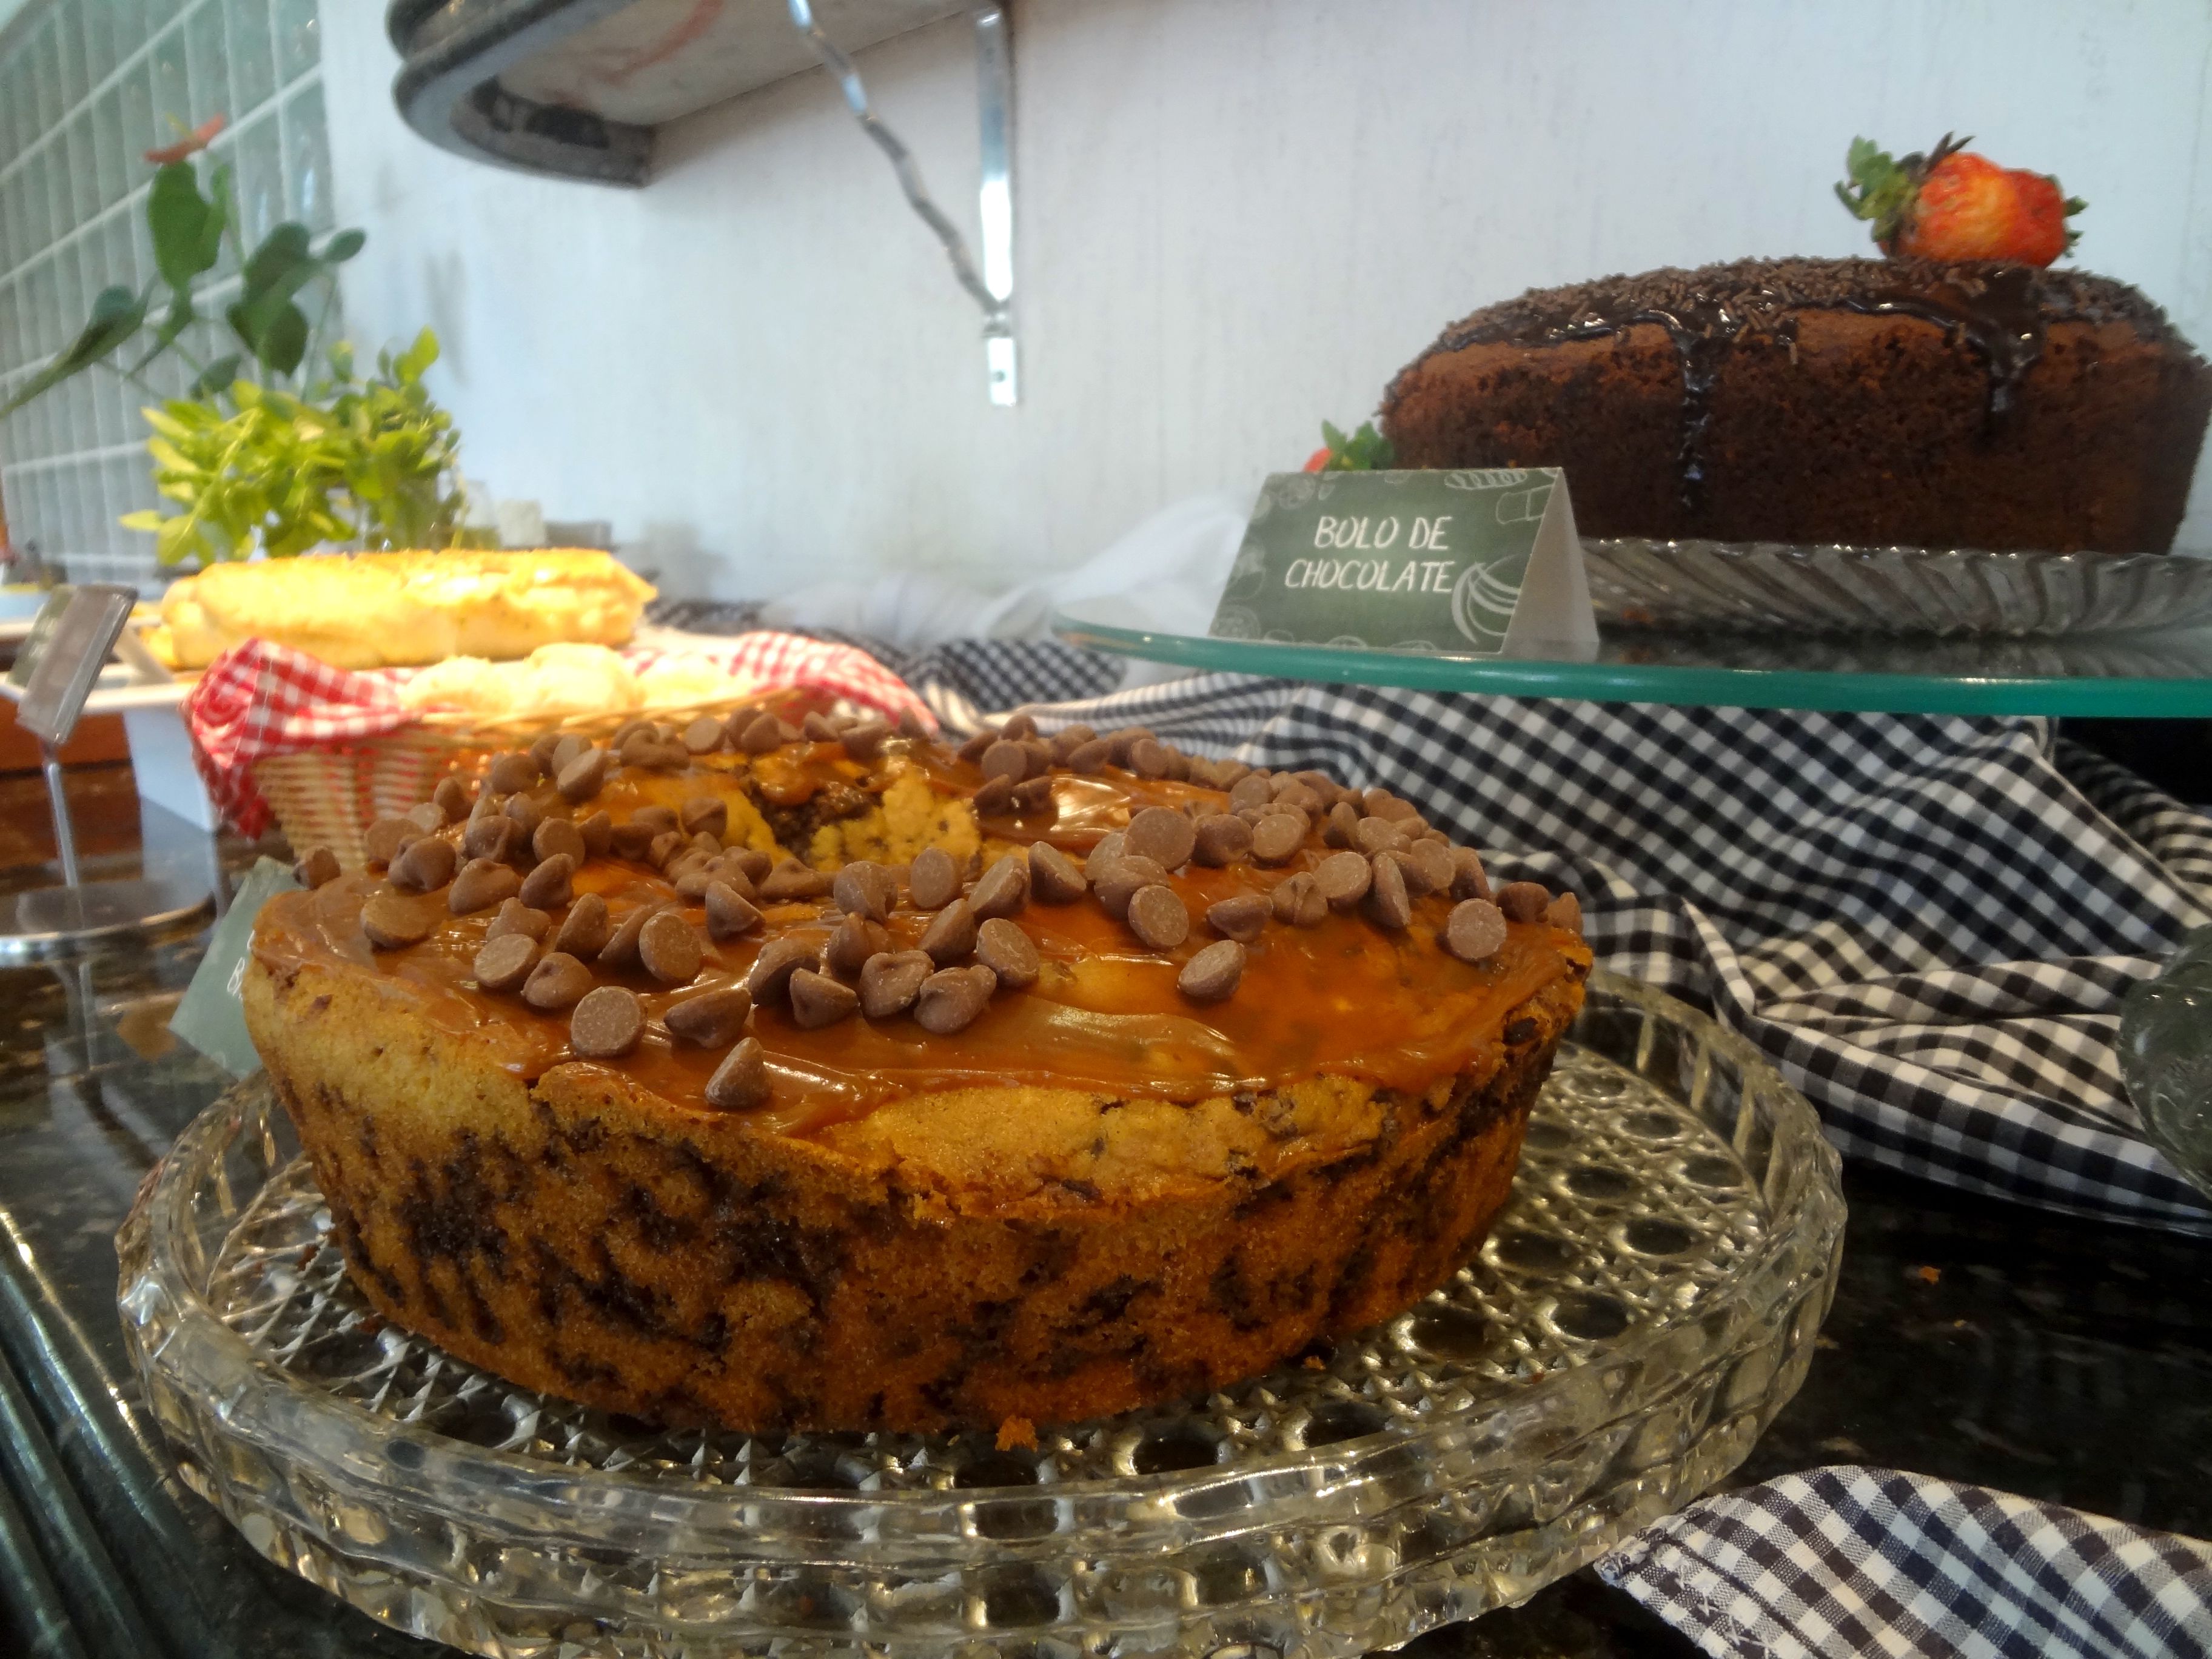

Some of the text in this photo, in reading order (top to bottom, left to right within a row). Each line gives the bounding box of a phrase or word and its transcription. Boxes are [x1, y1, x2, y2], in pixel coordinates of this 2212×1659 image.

[1314, 516, 1452, 549] BOLO DE
[1284, 558, 1455, 592] CHOCOLATE
